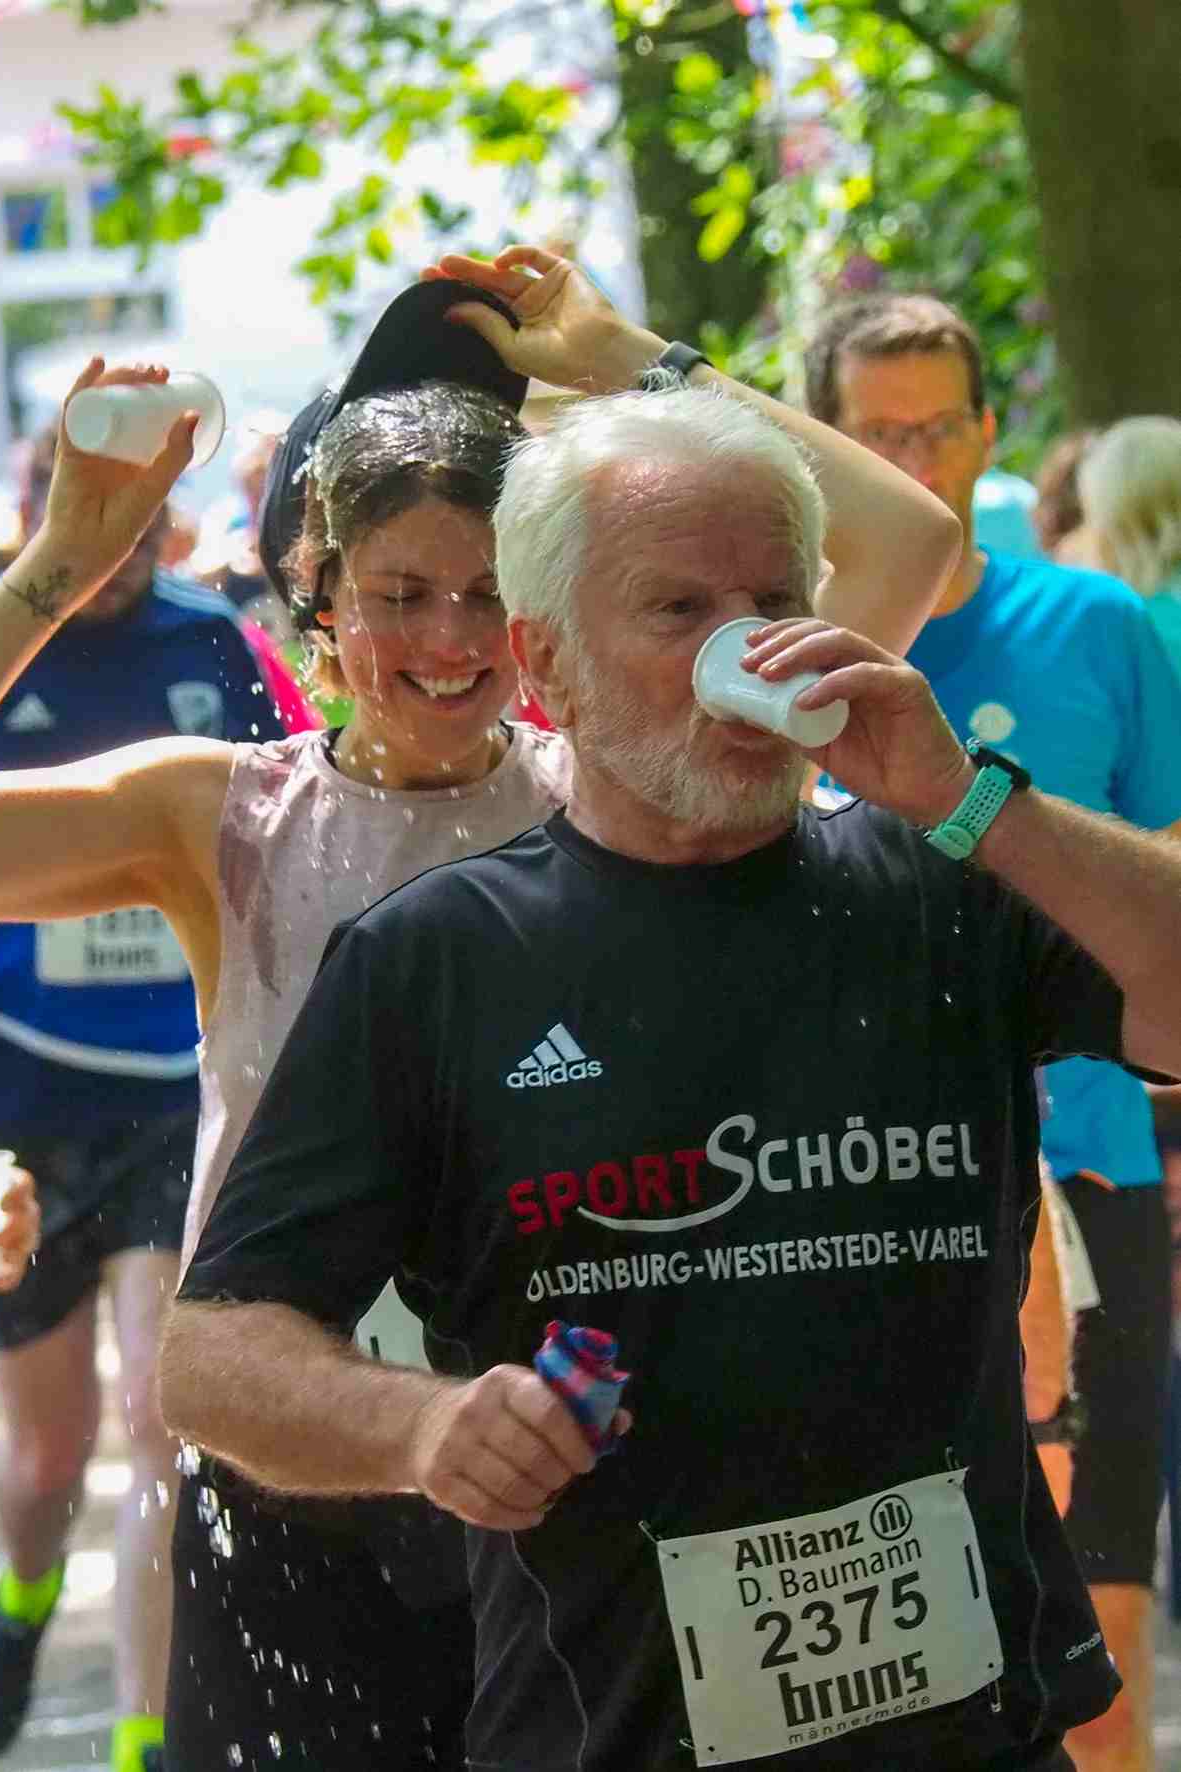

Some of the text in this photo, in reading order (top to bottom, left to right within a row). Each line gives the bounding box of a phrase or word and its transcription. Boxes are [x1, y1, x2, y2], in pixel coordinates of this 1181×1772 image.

[506, 1057, 603, 1089] adidas
[507, 1113, 981, 1234] SPORT SCHÖBEL
[525, 1224, 989, 1303] OLDENBURG-WESTERSTEDE-VAREL
[734, 1520, 864, 1571] Allianz
[738, 1537, 923, 1607] D. Baumann
[754, 1571, 928, 1669] 2375
[777, 1650, 929, 1727] bruns
[788, 1694, 931, 1745] männermode
